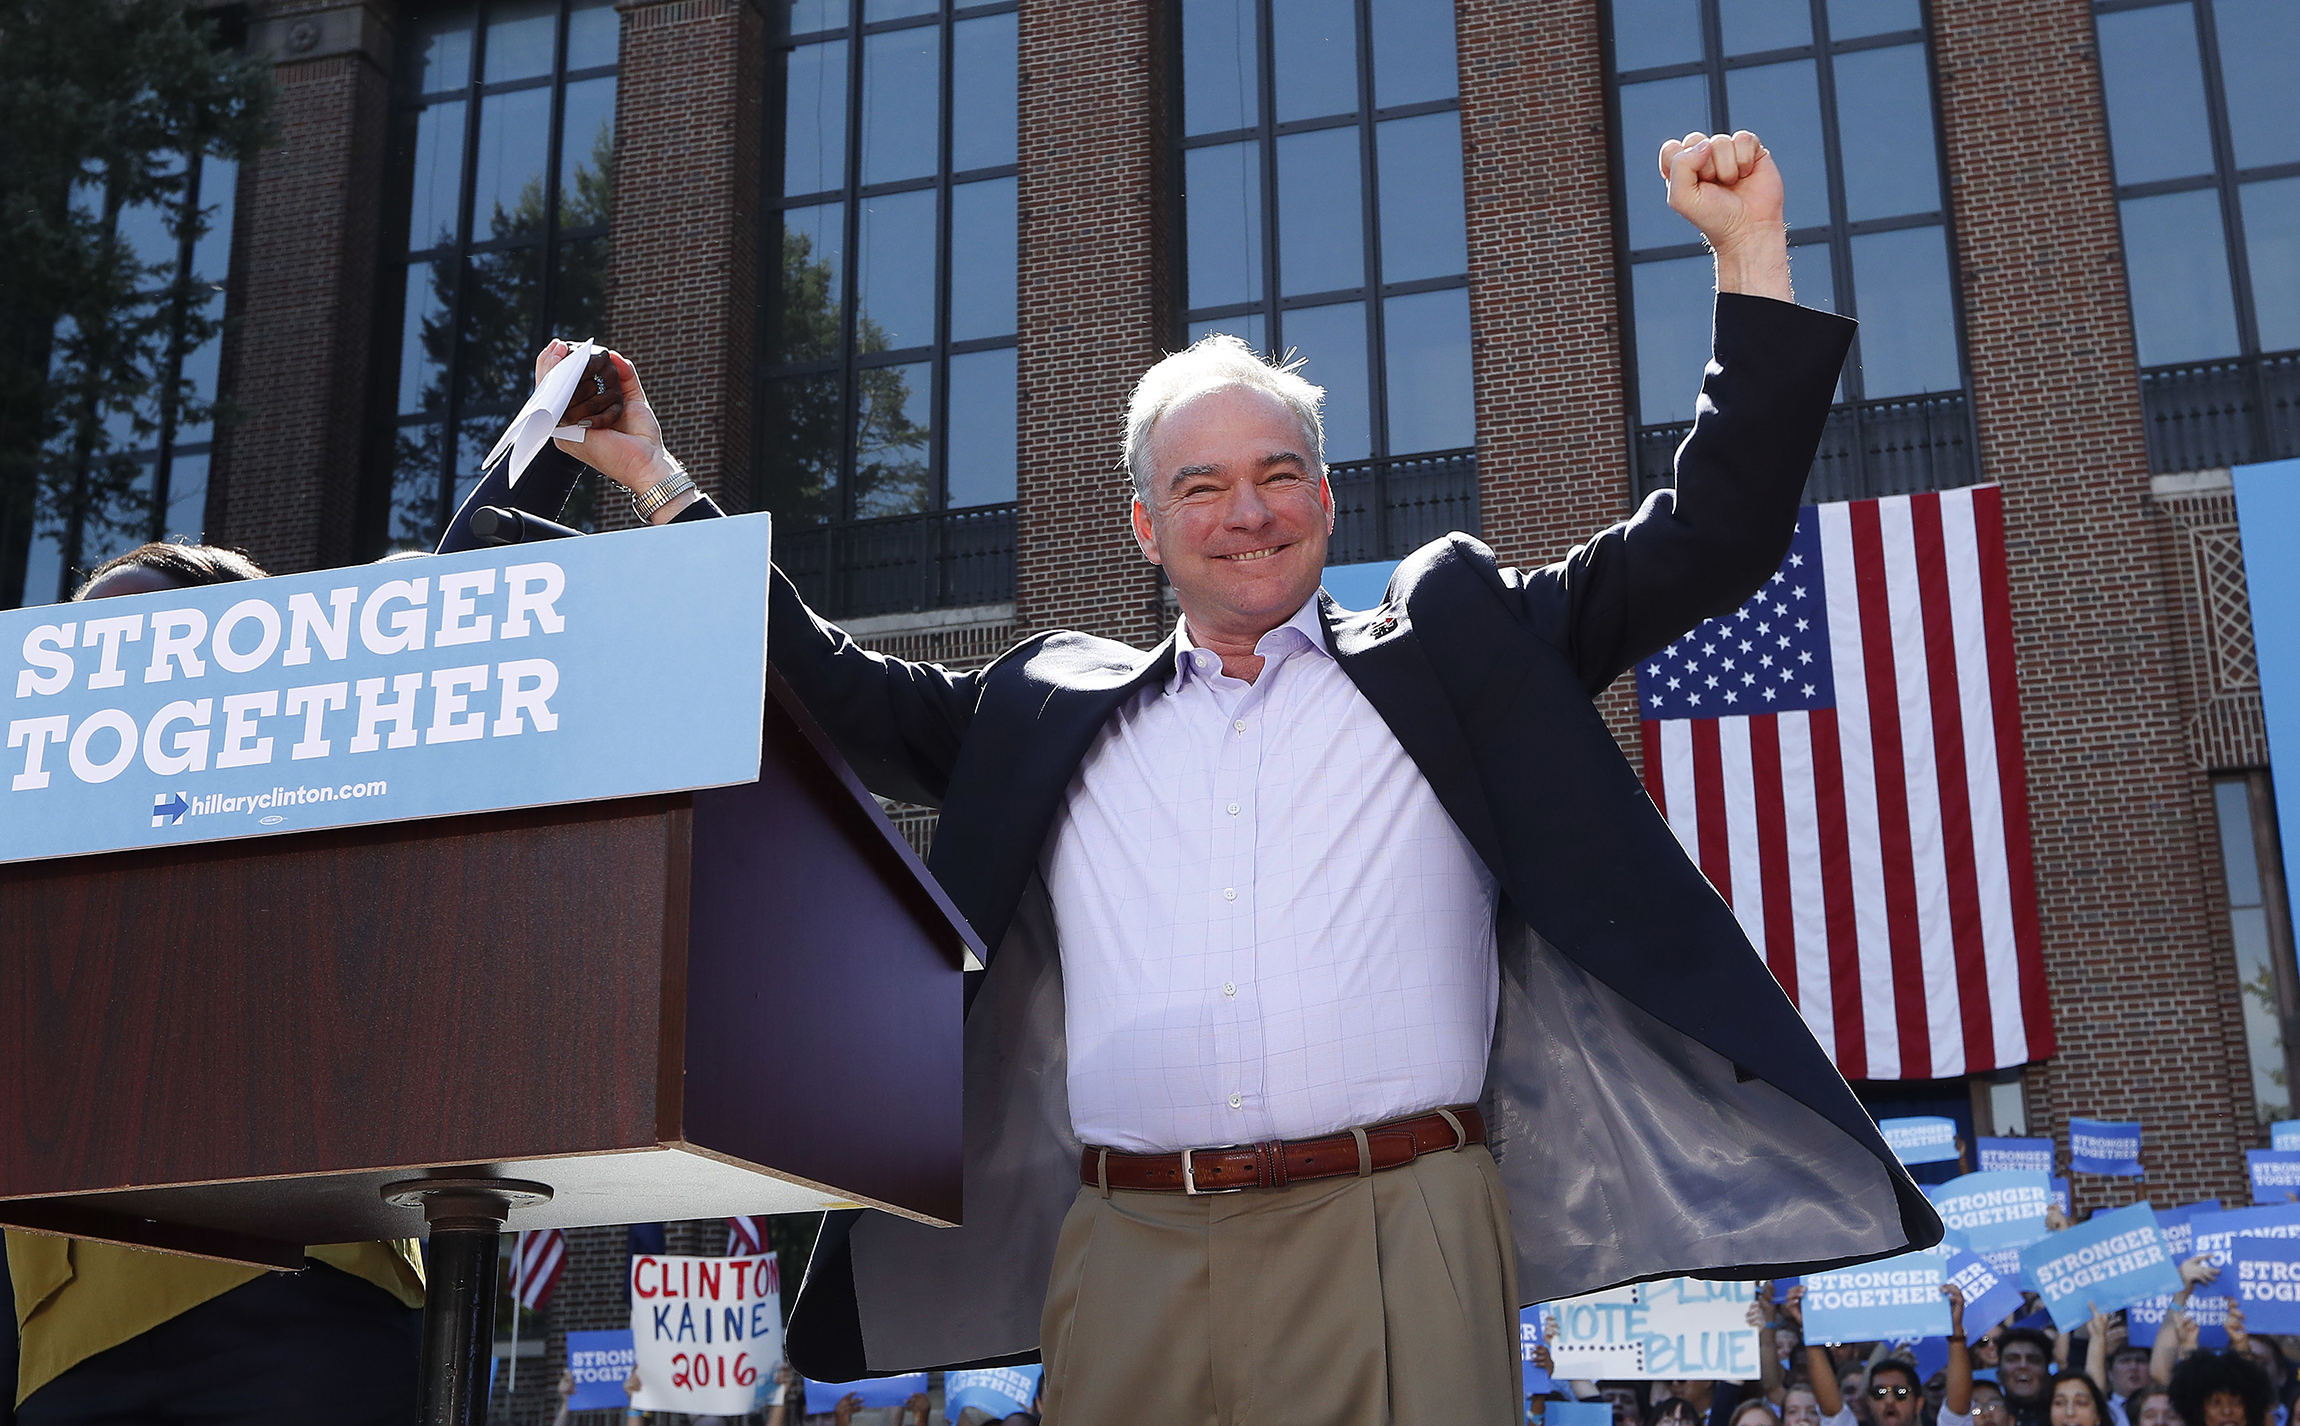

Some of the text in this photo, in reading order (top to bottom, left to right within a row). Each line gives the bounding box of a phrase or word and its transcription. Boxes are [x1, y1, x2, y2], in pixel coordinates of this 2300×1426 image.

[15, 560, 566, 698] STRONGER
[6, 657, 560, 791] TOGETHER
[190, 780, 387, 816] hillaryclinton.com
[1885, 1123, 1952, 1138] STRONGER
[2072, 1134, 2138, 1148] STRONGER
[1981, 1149, 2051, 1162] STRONGER
[1981, 1161, 2051, 1172] TOGETHER
[2072, 1145, 2138, 1160] TOGETHER
[1939, 1186, 2046, 1215] STRONGER
[2036, 1226, 2158, 1285] STRONGER
[2044, 1244, 2165, 1301] TOGETHER
[634, 1256, 780, 1300] CLINTON
[1807, 1269, 1942, 1292] STRONGER
[1808, 1285, 1942, 1311] TOGETHER
[653, 1302, 769, 1344] KAINE
[1552, 1302, 1651, 1344] VOTE
[572, 1349, 633, 1367] STRON
[1643, 1330, 1757, 1374] BLUE
[672, 1352, 757, 1391] 2016
